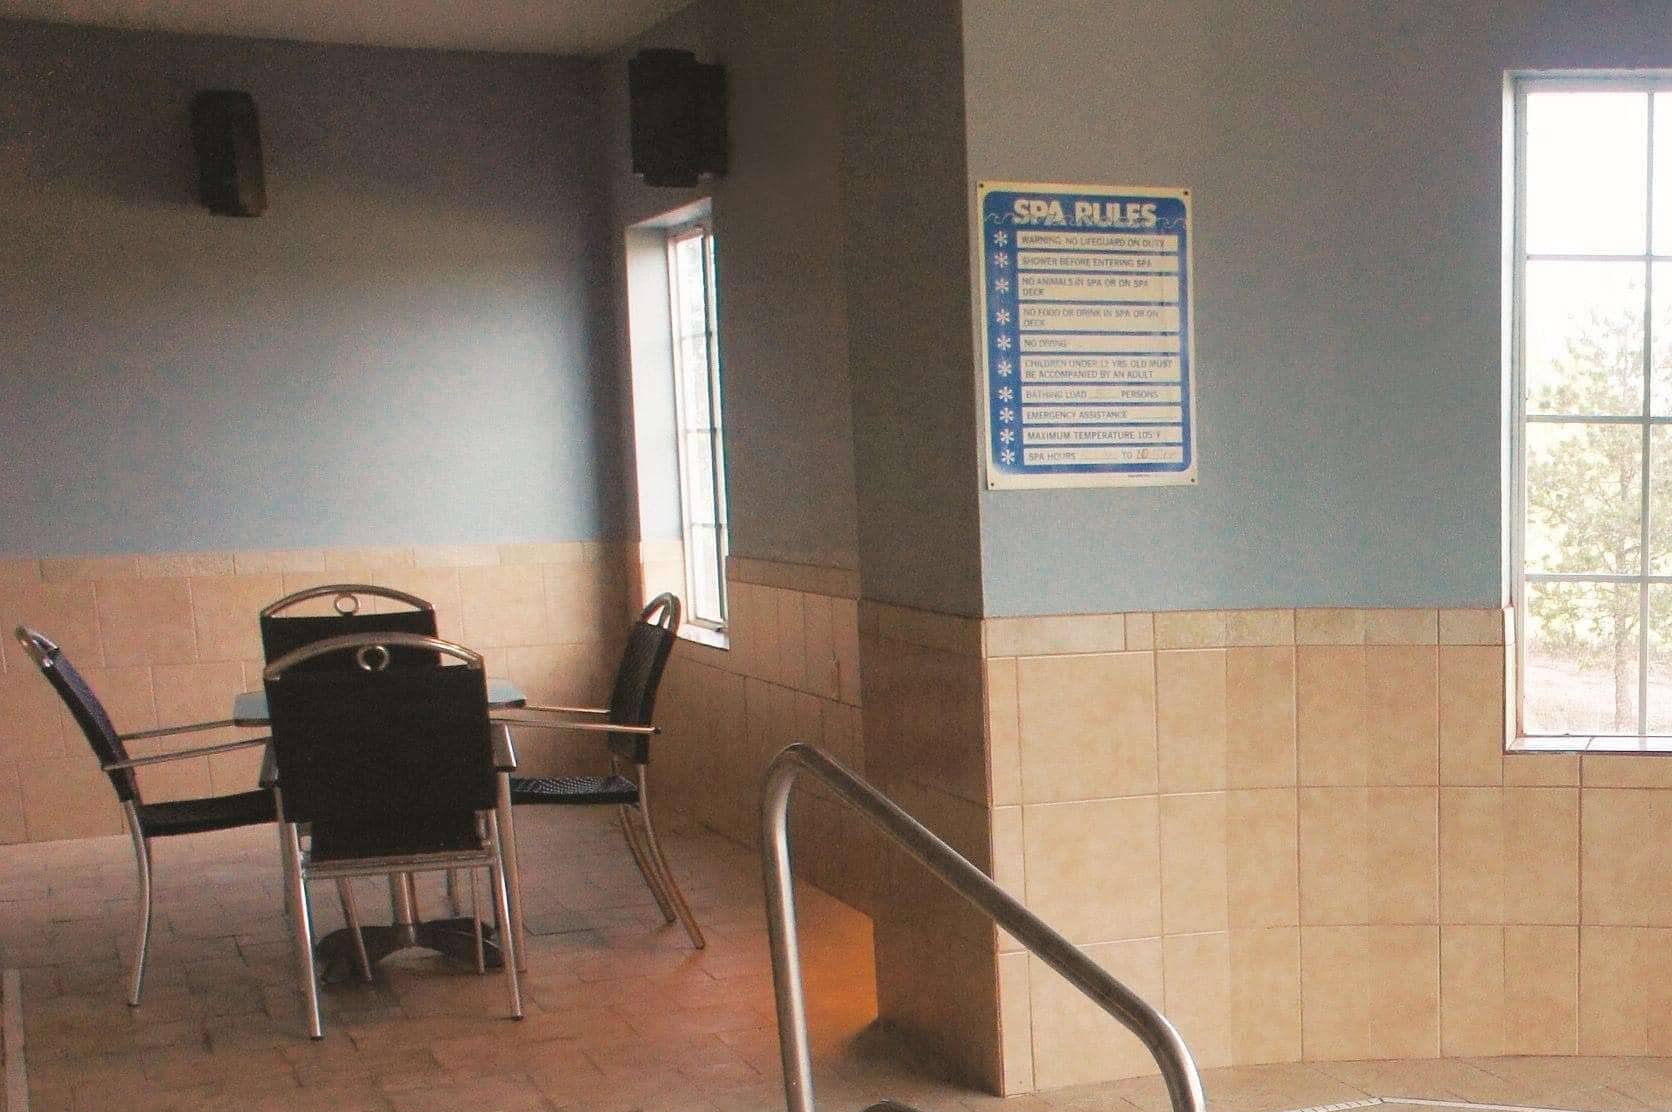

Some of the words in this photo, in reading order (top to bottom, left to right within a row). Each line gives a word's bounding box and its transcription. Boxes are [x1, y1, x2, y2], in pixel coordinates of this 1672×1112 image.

[1013, 199, 1067, 226] SPA
[1074, 202, 1157, 228] RULES
[1066, 236, 1078, 245] NO
[1080, 236, 1126, 246] LIFEGUARD
[1127, 238, 1139, 247] ON
[1022, 256, 1057, 265] SHOWER
[1060, 257, 1090, 266] BEFORE
[1093, 258, 1134, 267] ENTERING
[1022, 277, 1035, 286] NO
[1037, 277, 1072, 286] ANIMALS
[1075, 278, 1084, 286] IN
[1087, 278, 1102, 287] SPA
[1022, 288, 1044, 296] DECK
[1023, 307, 1036, 316] NO
[1038, 308, 1061, 317] FOOD
[1114, 309, 1130, 317] SPA
[1023, 319, 1045, 327] DECK
[1024, 339, 1037, 347] NO
[1039, 339, 1067, 347] DIVING
[1025, 360, 1067, 368] CHILDREN
[1069, 360, 1097, 368] UNDER
[1130, 360, 1147, 368] OLD
[1149, 360, 1172, 368] MUST
[1025, 370, 1037, 379] BE
[1039, 370, 1098, 379] ACCOMPANIED
[1100, 370, 1112, 379] BY
[1113, 370, 1125, 379] AN
[1127, 370, 1153, 379] ADULT
[1025, 390, 1063, 399] BATHING
[1065, 390, 1087, 399] LOAD
[1121, 390, 1158, 399] PERSONS
[1026, 410, 1076, 419] EMERGENCY
[1079, 410, 1128, 419] ASSISTANCE
[1027, 431, 1071, 440] MAXIMUM
[1073, 430, 1135, 440] TEMPERATURE
[1028, 452, 1045, 461] SPA
[1047, 452, 1076, 461] HOURS
[1122, 452, 1133, 460] TO
